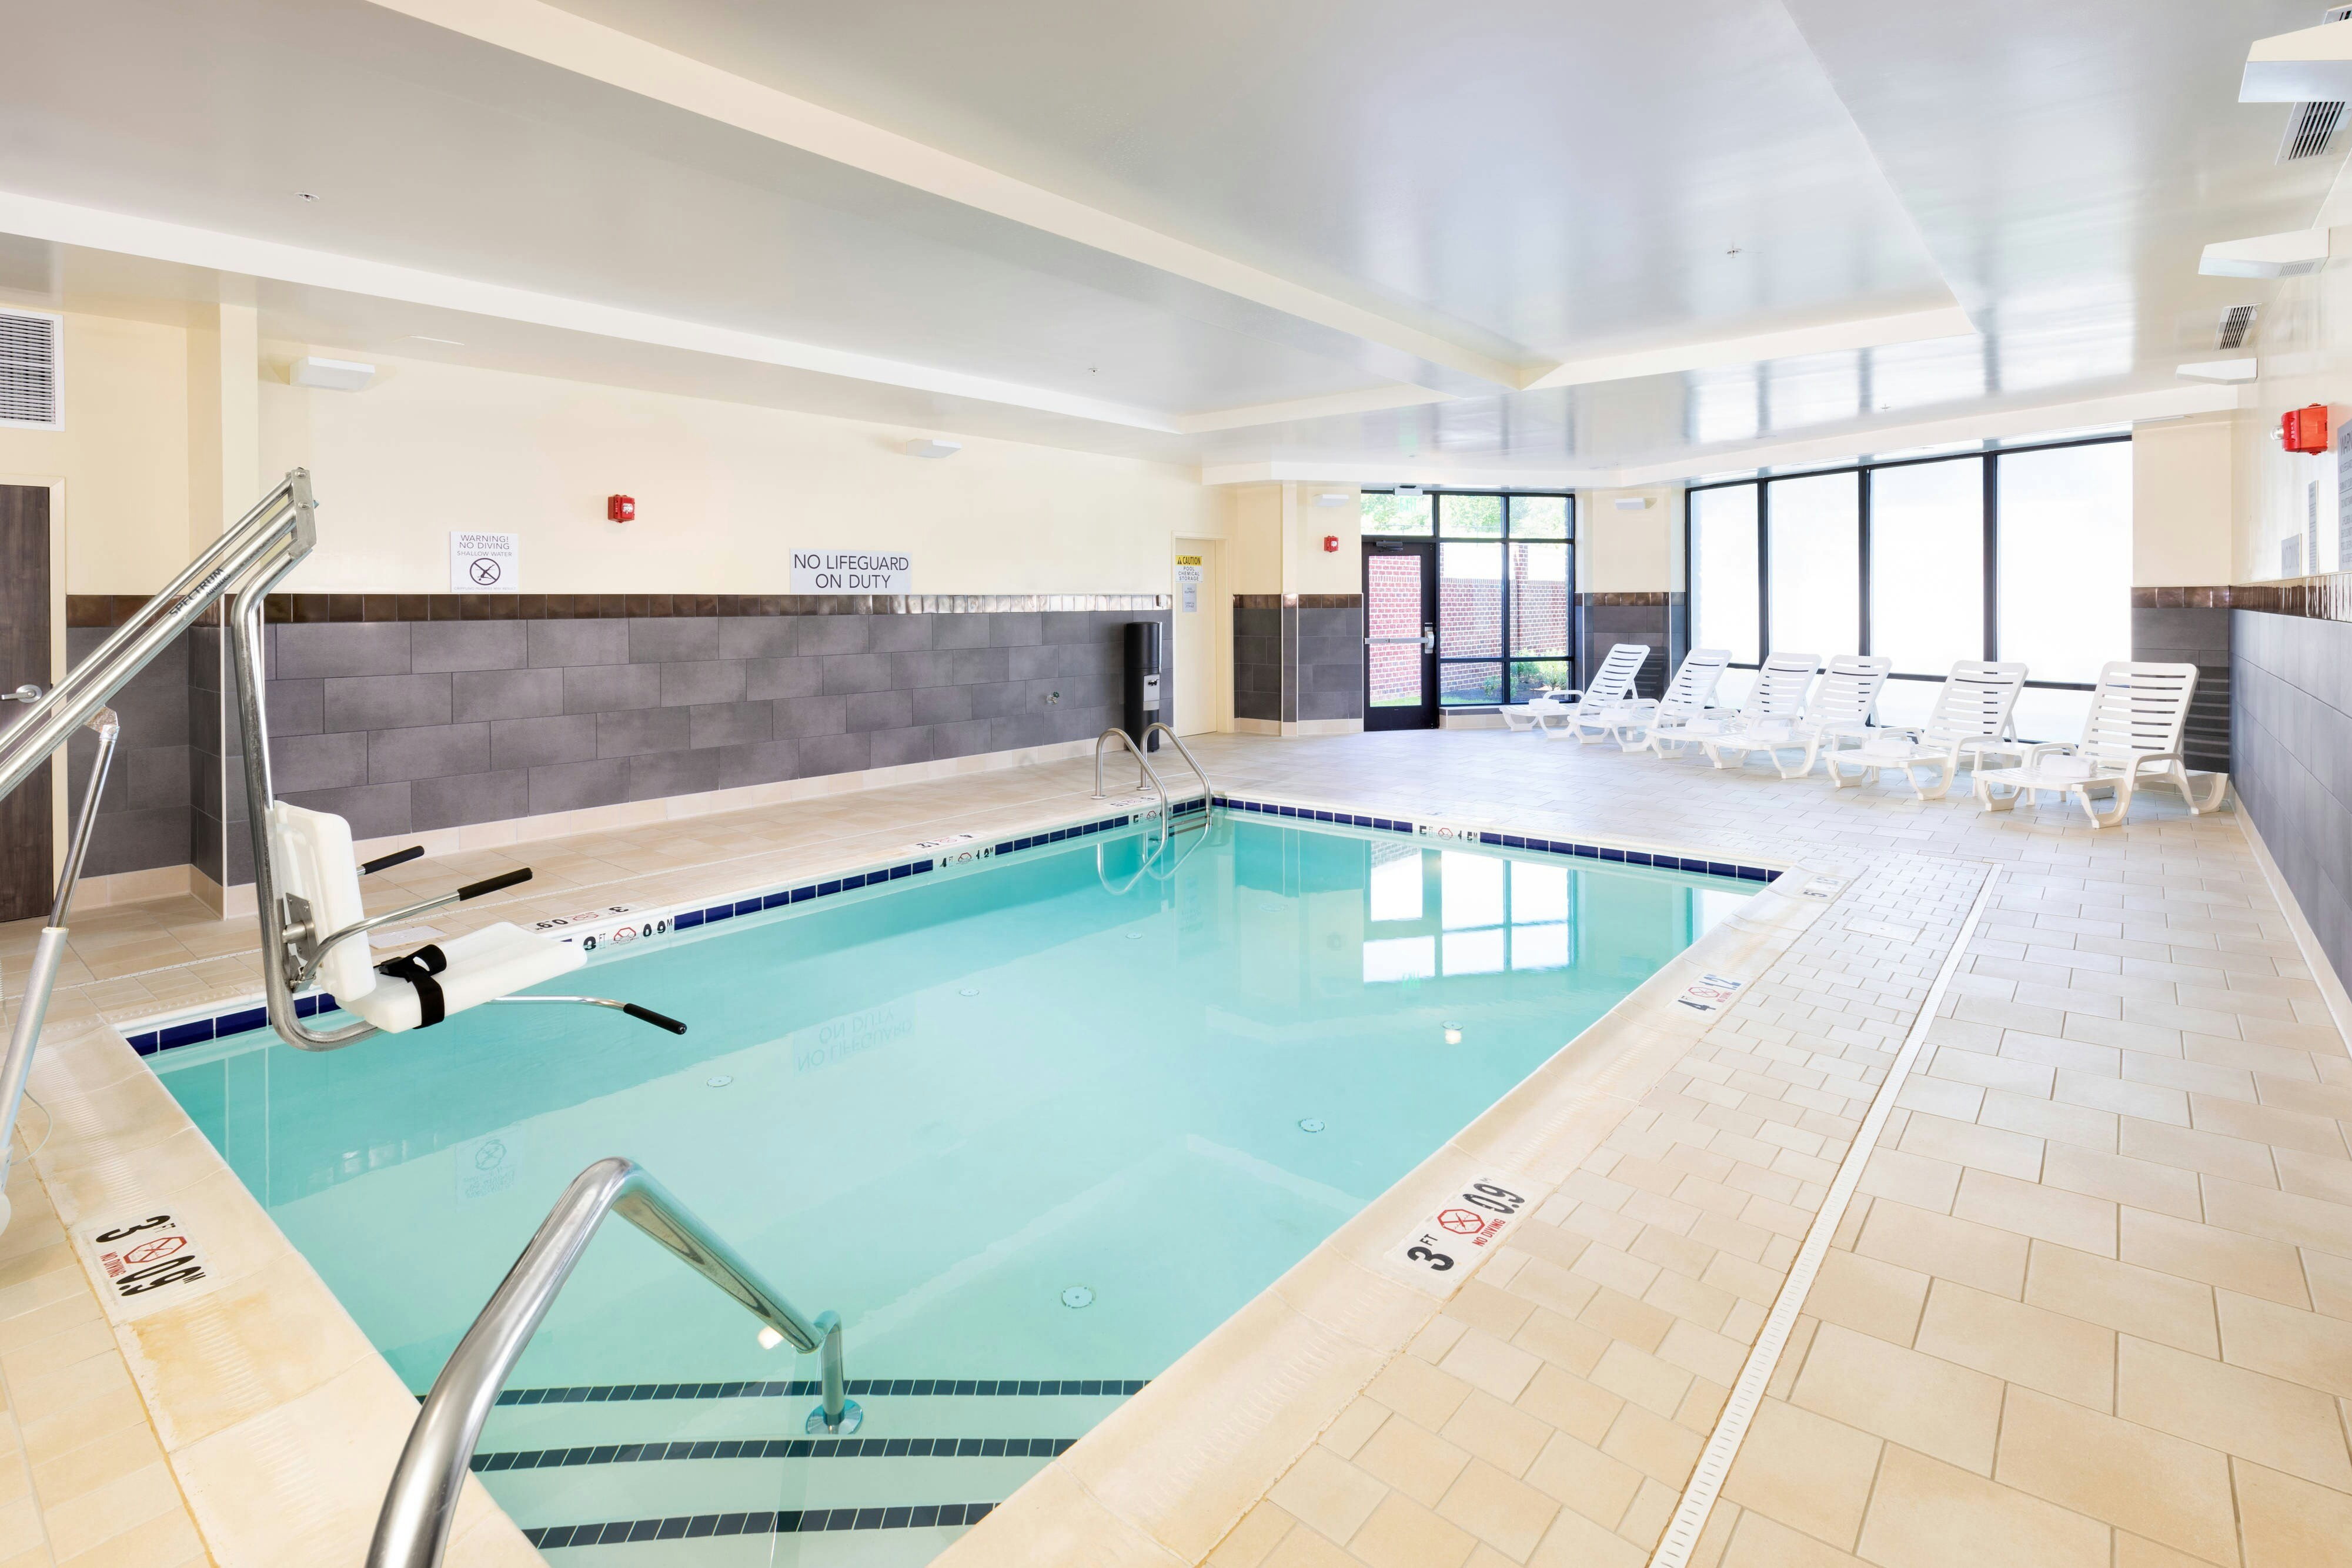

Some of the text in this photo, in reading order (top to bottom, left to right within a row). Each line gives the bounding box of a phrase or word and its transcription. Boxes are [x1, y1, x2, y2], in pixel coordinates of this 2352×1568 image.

[460, 534, 509, 543] WARNING!
[794, 554, 909, 570] NO LIFEGUARD
[1182, 556, 1201, 565] CAUTION
[169, 568, 223, 617] SPECTRUM
[816, 573, 891, 589] ON DUTY
[667, 918, 673, 927] M
[1462, 1183, 1525, 1214] 0.9
[96, 1215, 171, 1243] 3
[1472, 1218, 1506, 1247] NO DIVING
[100, 1251, 126, 1278] NO DIVING
[1407, 1233, 1454, 1271] 3 FT
[116, 1255, 202, 1296] 0.9
